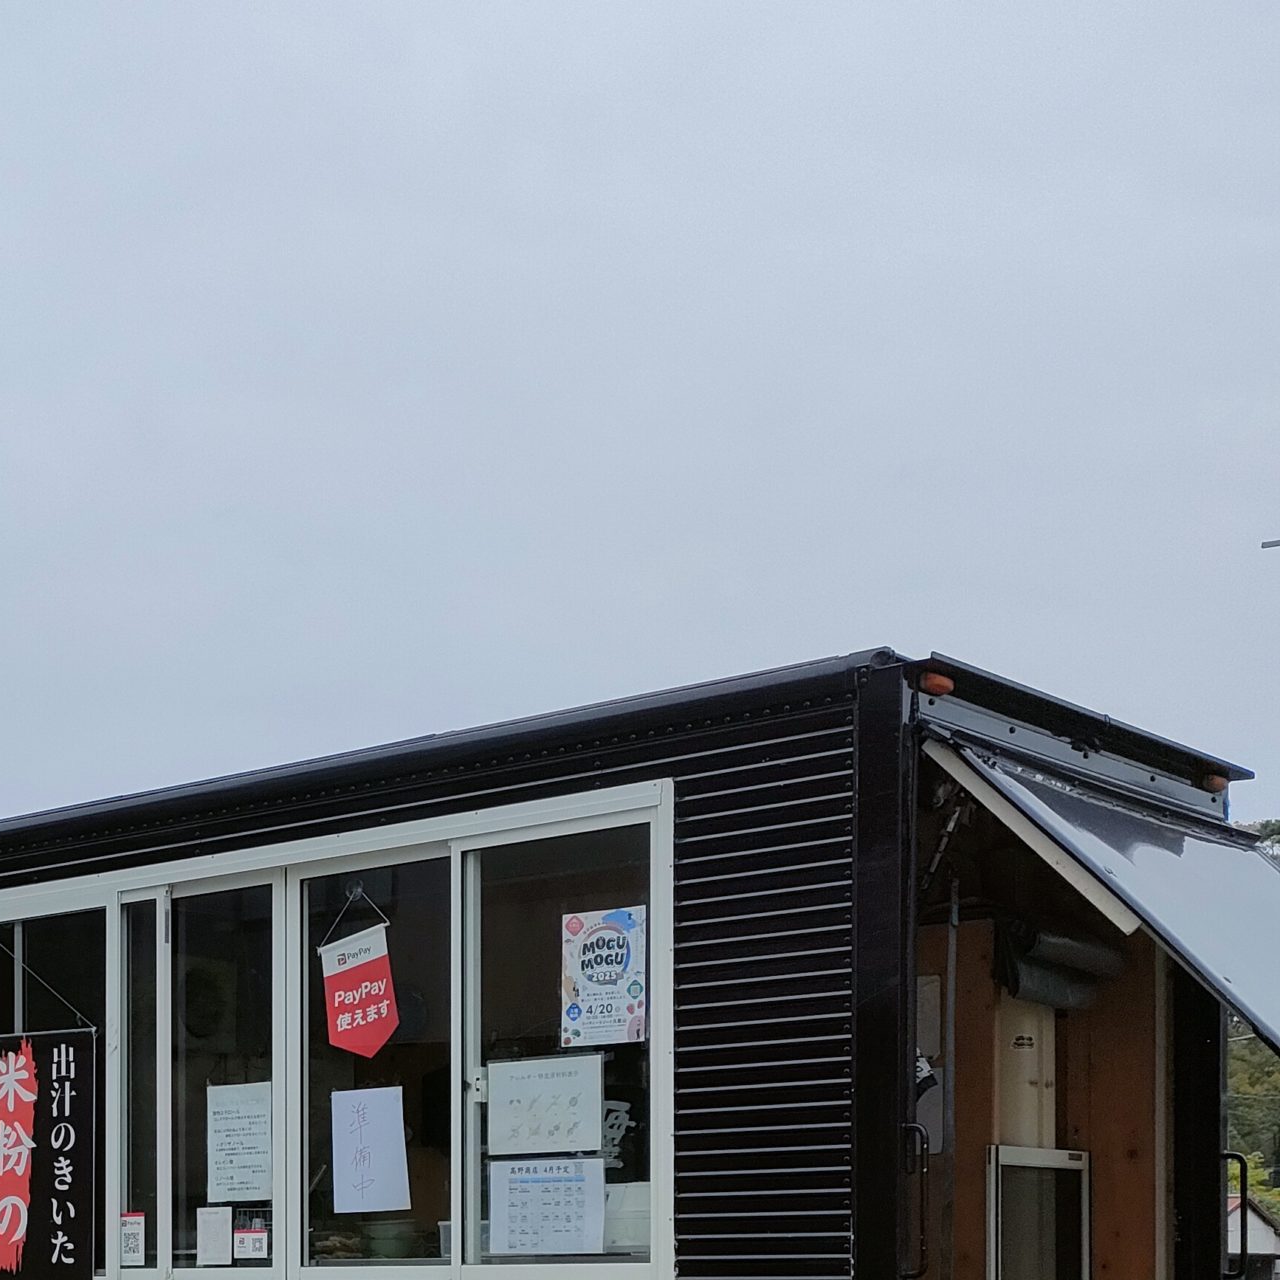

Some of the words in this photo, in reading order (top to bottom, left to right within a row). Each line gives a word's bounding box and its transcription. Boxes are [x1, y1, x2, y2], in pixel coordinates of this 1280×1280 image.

[347, 945, 372, 960] PayPay
[582, 936, 627, 956] MOGU
[581, 953, 625, 971] MOGU
[592, 971, 617, 982] 2025
[334, 977, 388, 1008] PayPay
[336, 1000, 391, 1033] 使えます
[585, 1003, 613, 1016] 4/20
[50, 1044, 77, 1265] 出汁のきいた
[349, 1101, 376, 1200] 準備中
[510, 1166, 539, 1175] 高野商店
[544, 1165, 570, 1175] 4月予定
